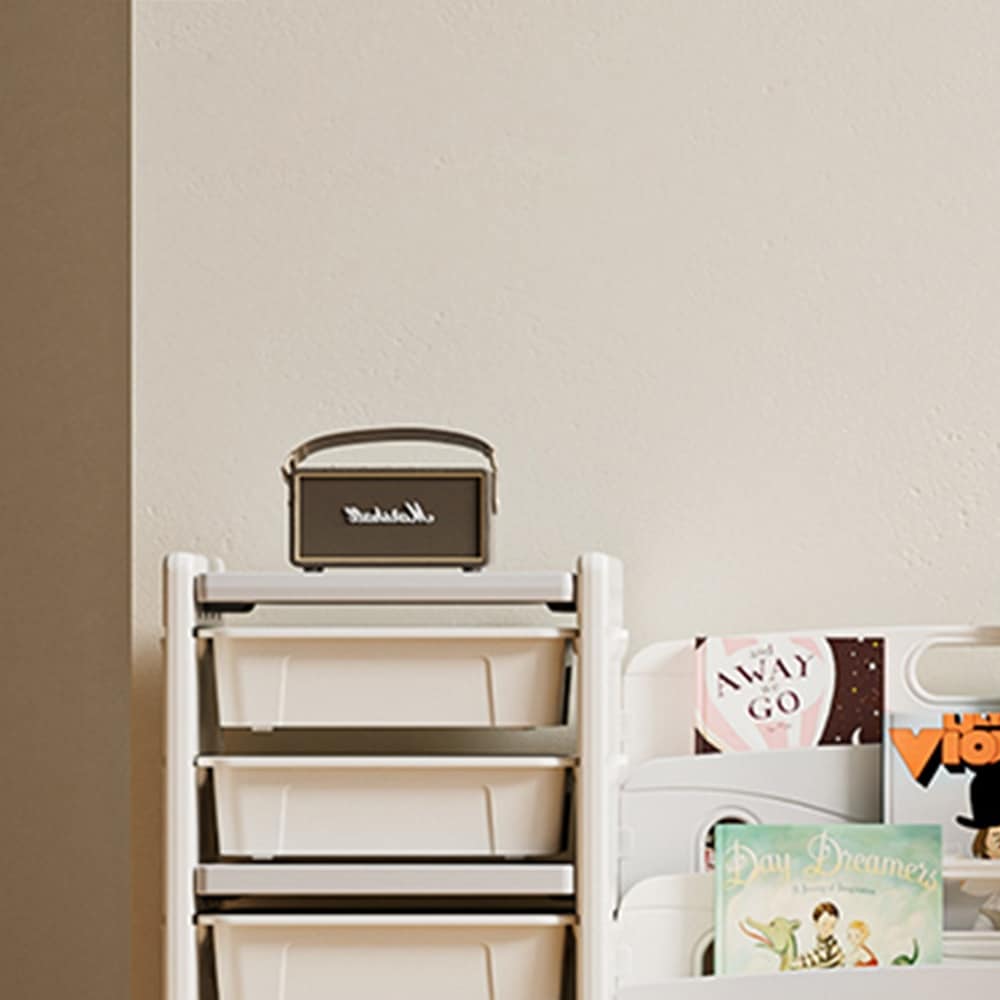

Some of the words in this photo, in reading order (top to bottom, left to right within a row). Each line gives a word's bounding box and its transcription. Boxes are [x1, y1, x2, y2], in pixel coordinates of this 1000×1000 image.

[717, 654, 814, 698] AWAY
[748, 690, 801, 721] GO
[725, 839, 792, 888] Day
[803, 831, 939, 891] Dreamers
